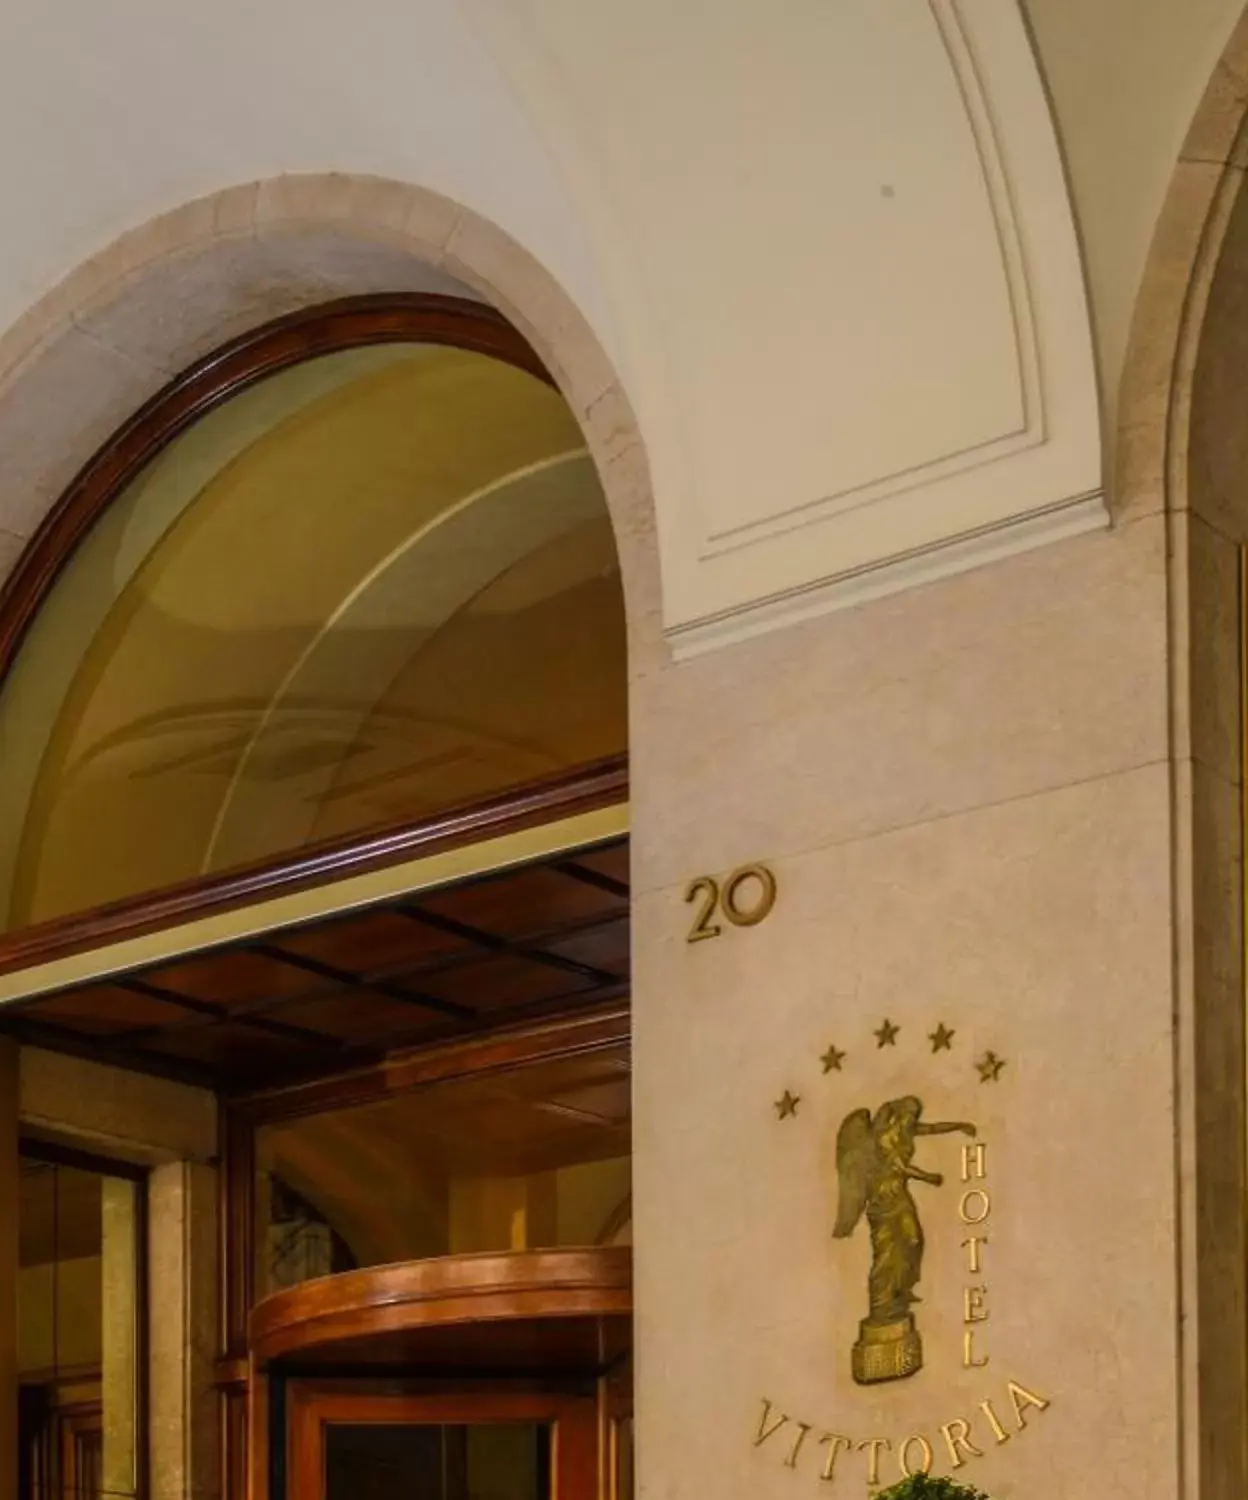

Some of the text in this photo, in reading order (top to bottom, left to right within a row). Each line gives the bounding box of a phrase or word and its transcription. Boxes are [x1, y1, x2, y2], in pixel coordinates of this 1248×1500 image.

[685, 865, 777, 943] 20
[959, 1143, 990, 1368] HOTEL
[753, 1380, 1051, 1485] VITTORIA
